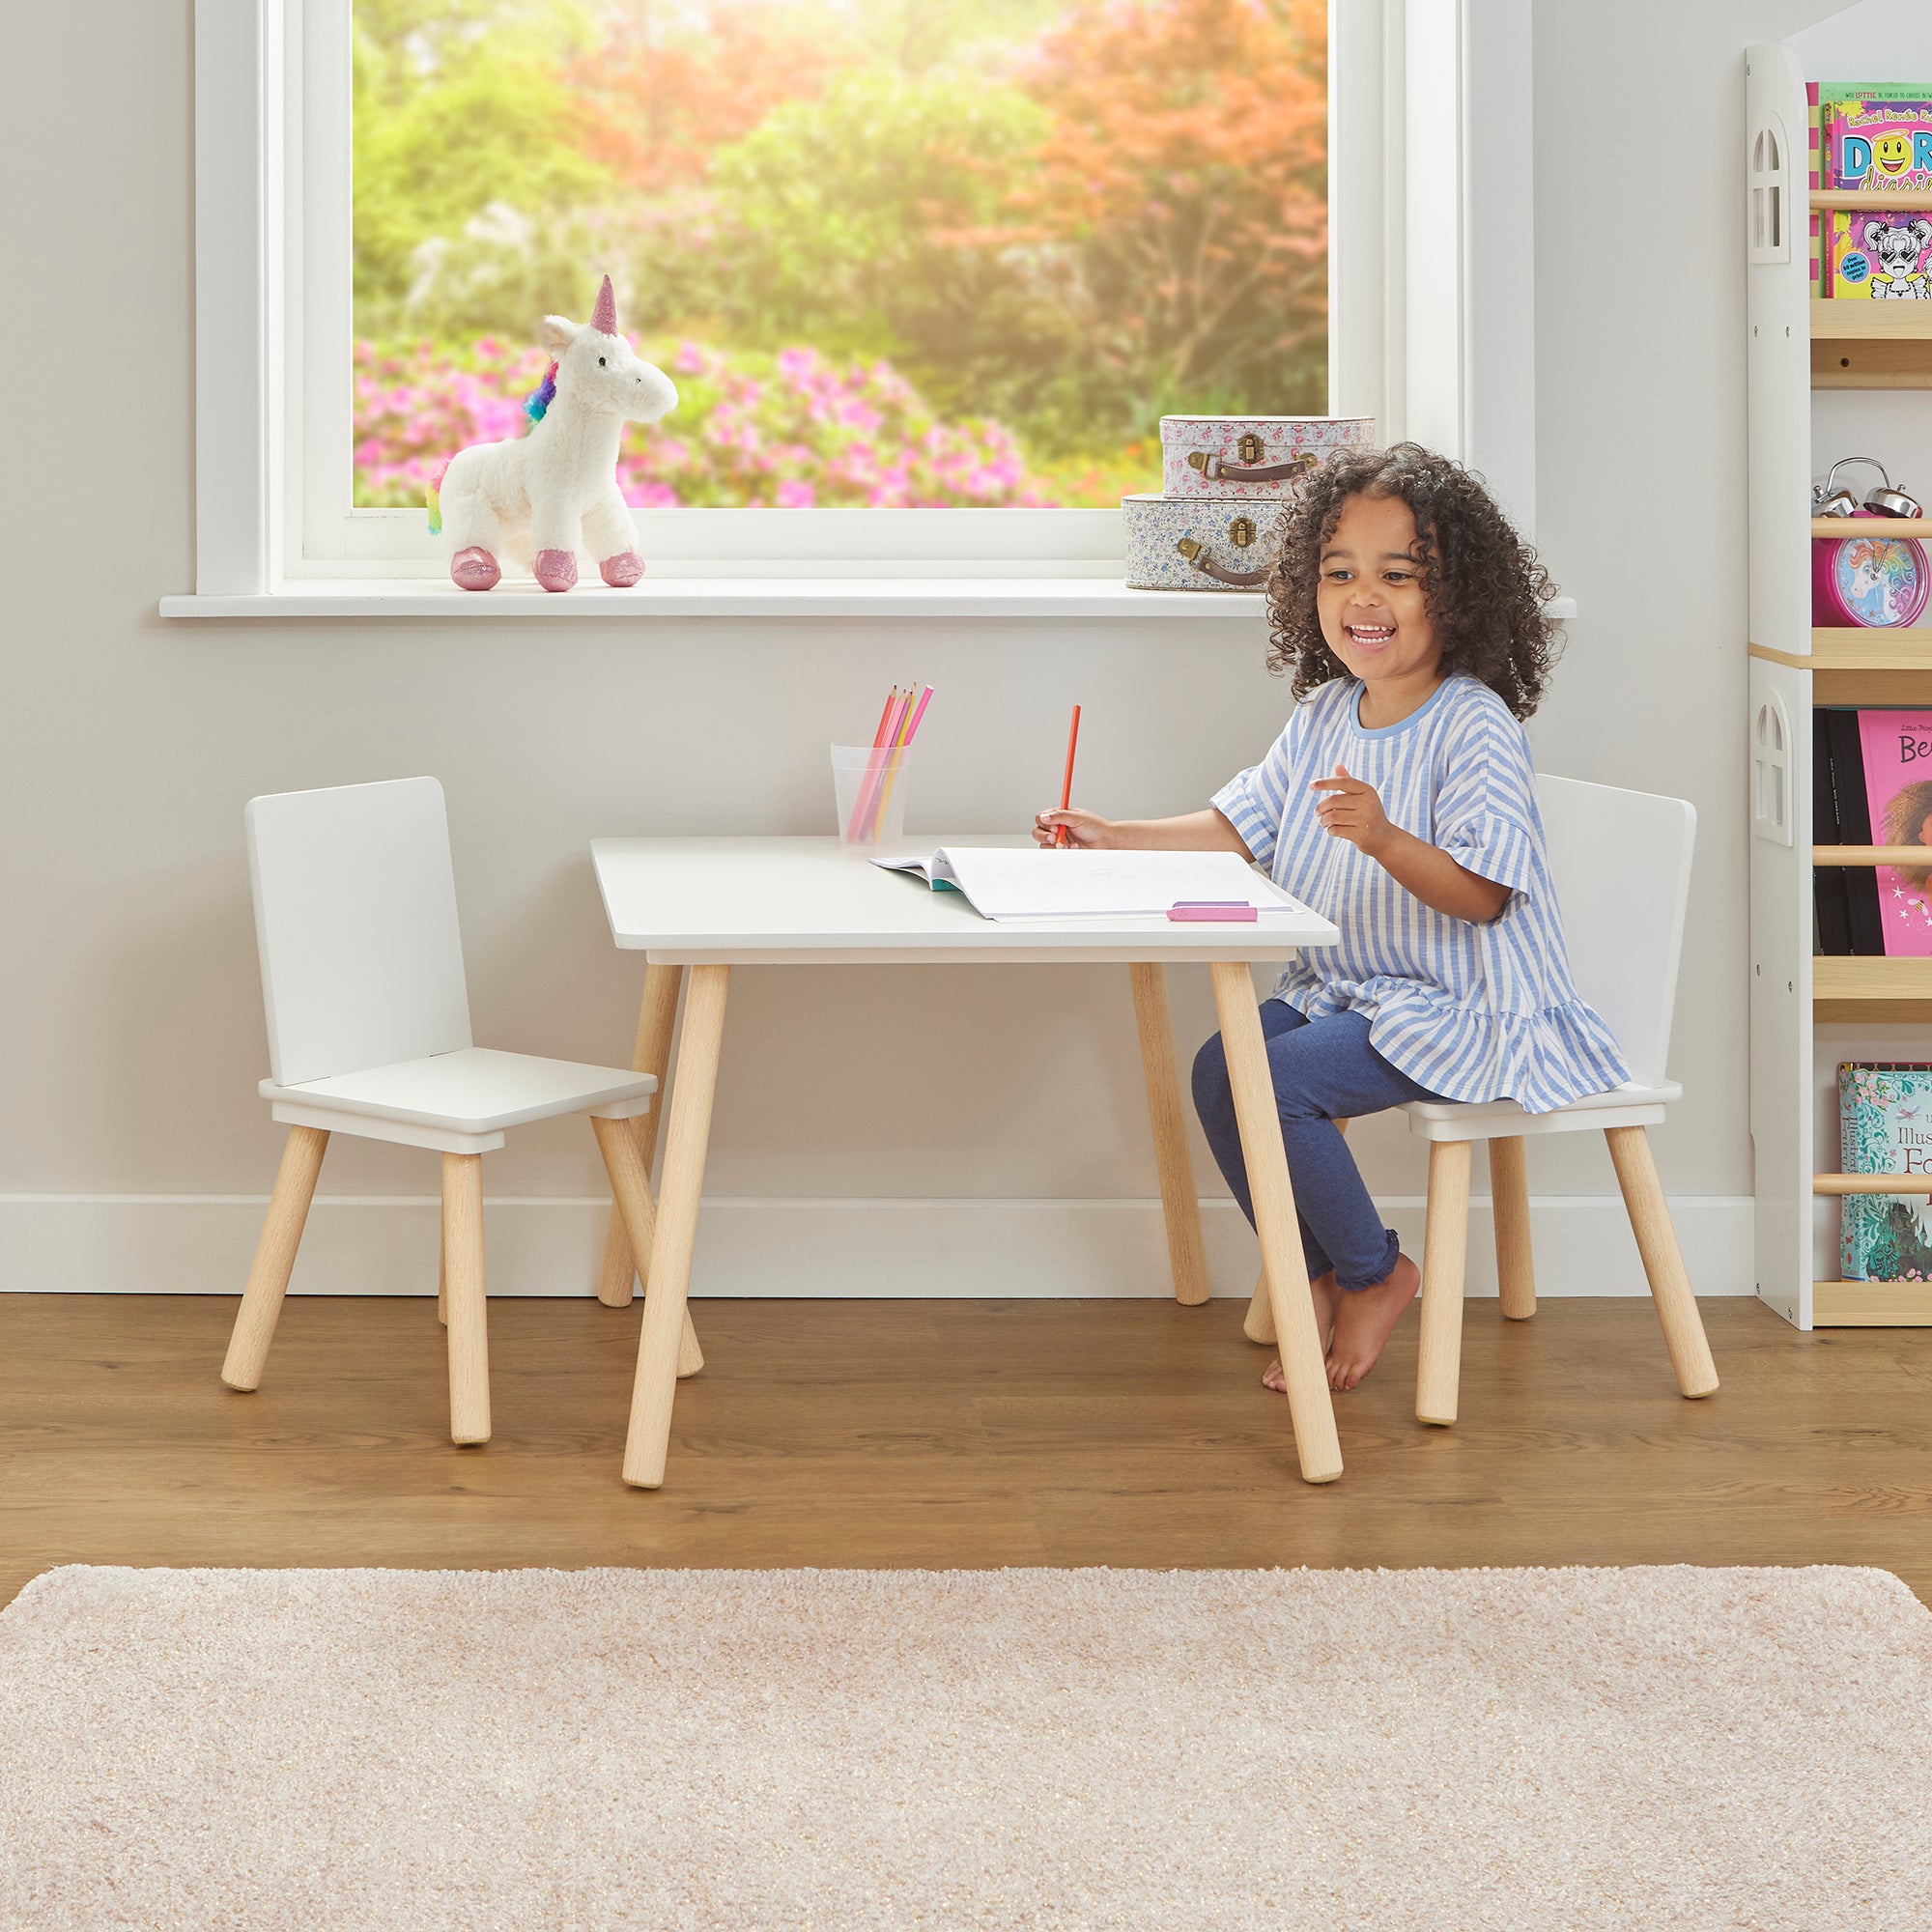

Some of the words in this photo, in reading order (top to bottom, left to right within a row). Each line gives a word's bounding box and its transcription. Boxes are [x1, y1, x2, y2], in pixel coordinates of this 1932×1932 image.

[1848, 110, 1884, 128] Rachel
[1886, 108, 1918, 122] Renée
[1898, 735, 1932, 763] Be
[1849, 1117, 1859, 1175] Illustrat
